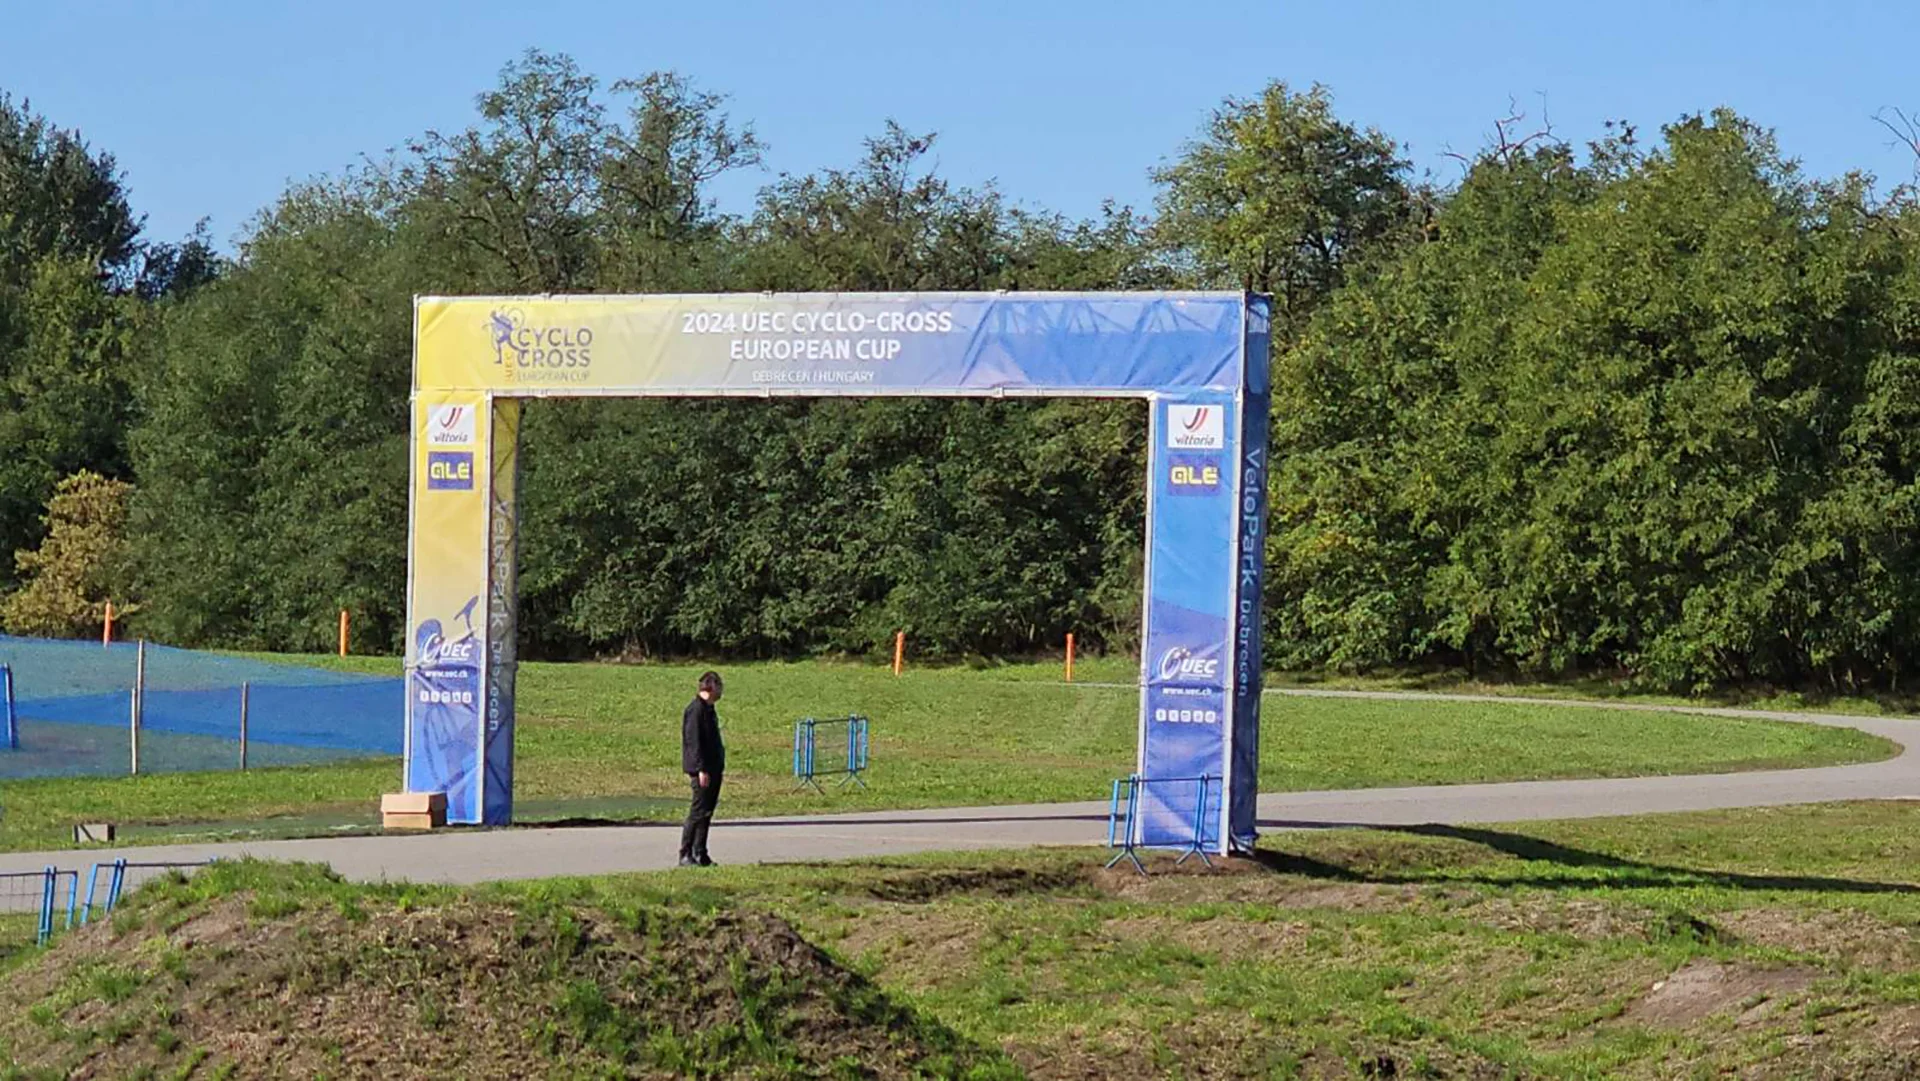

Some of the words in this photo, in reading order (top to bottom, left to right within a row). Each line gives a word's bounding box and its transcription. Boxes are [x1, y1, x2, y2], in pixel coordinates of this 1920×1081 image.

[682, 312, 736, 334] 2024
[742, 312, 786, 333] UEC
[791, 311, 953, 333] CYCLO-CROSS
[517, 327, 593, 347] CYCLO
[517, 348, 591, 368] CROSS
[730, 339, 850, 360] EUROPEAN
[855, 339, 901, 360] CUP
[752, 370, 811, 383] DEBRECEN
[818, 370, 875, 383] HUNGARY
[433, 432, 469, 443] vittoria
[1175, 434, 1215, 446] vittoria
[1241, 448, 1260, 586] VeloPark
[440, 643, 472, 657] UEC
[1238, 600, 1252, 697] Debrecen
[1181, 659, 1218, 674] UEC
[1162, 687, 1212, 696] www.uec.ch
